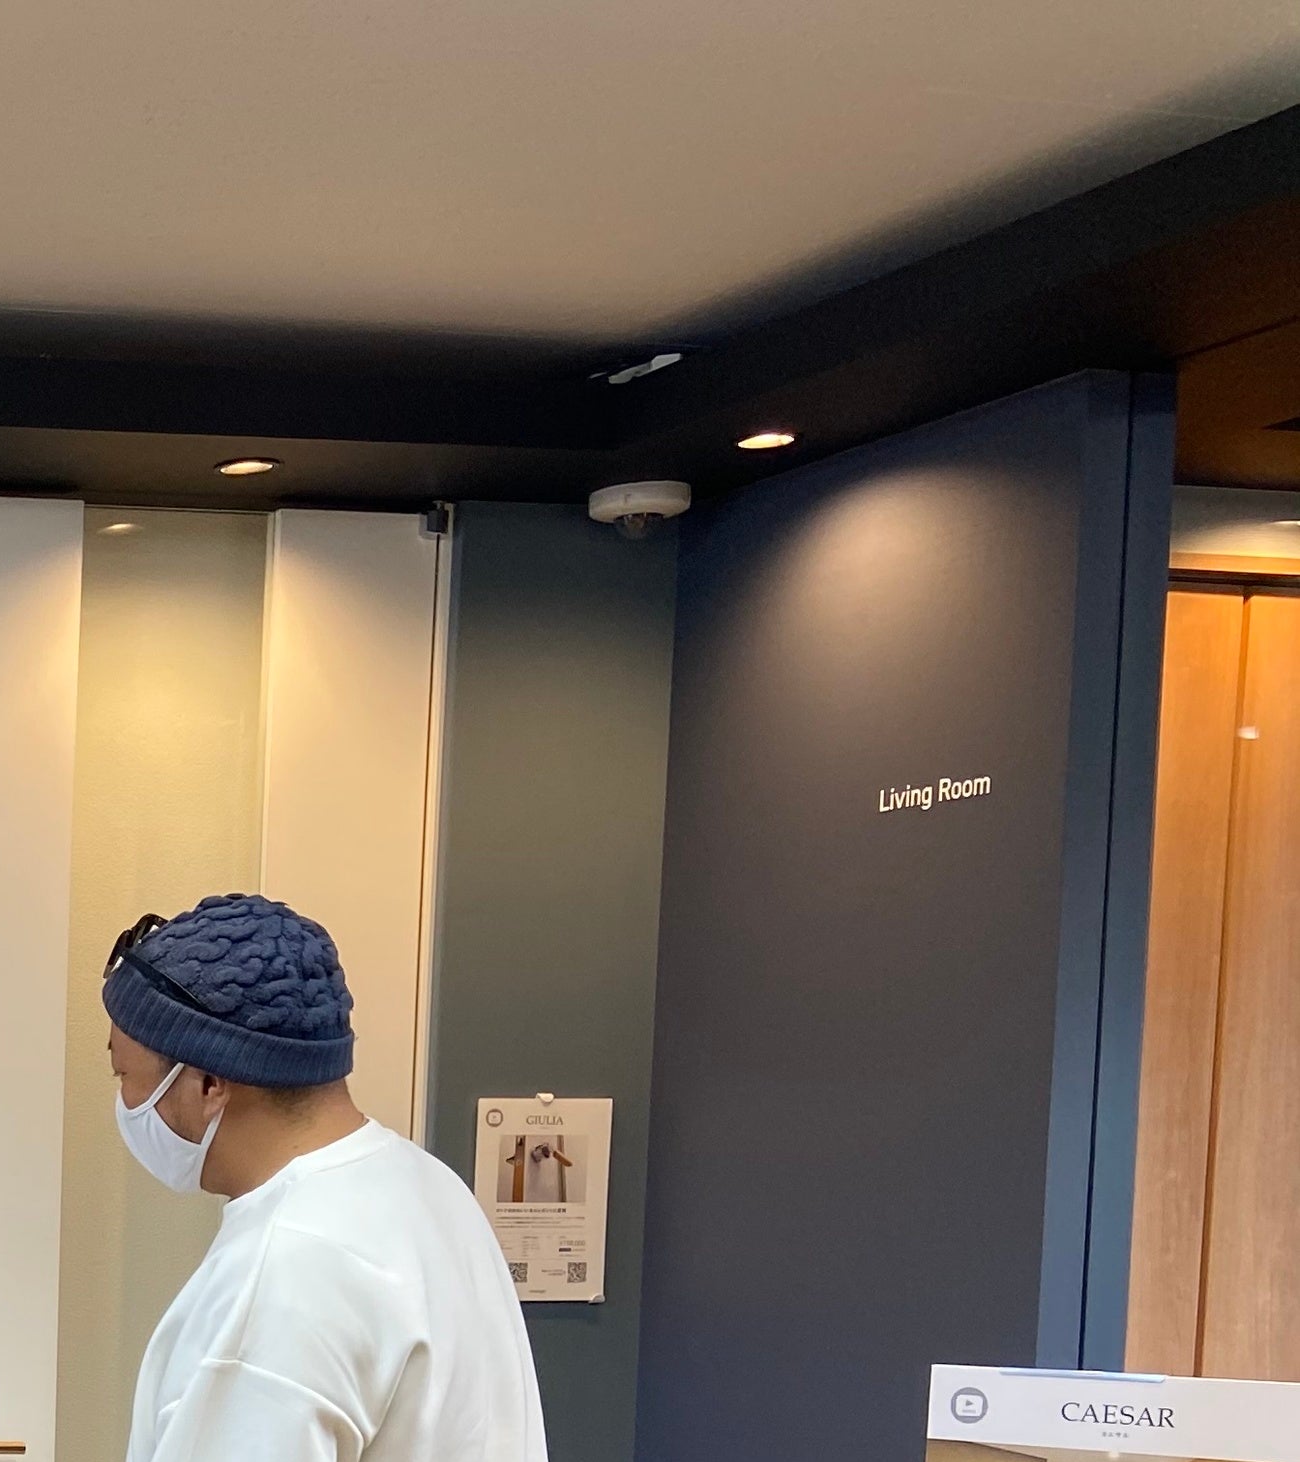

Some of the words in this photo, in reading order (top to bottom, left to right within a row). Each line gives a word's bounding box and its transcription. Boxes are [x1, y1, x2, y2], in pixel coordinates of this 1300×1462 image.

[879, 784, 933, 812] Living
[937, 775, 992, 802] Room
[526, 1114, 564, 1126] GIULIA
[1061, 1401, 1175, 1428] CAESAR
